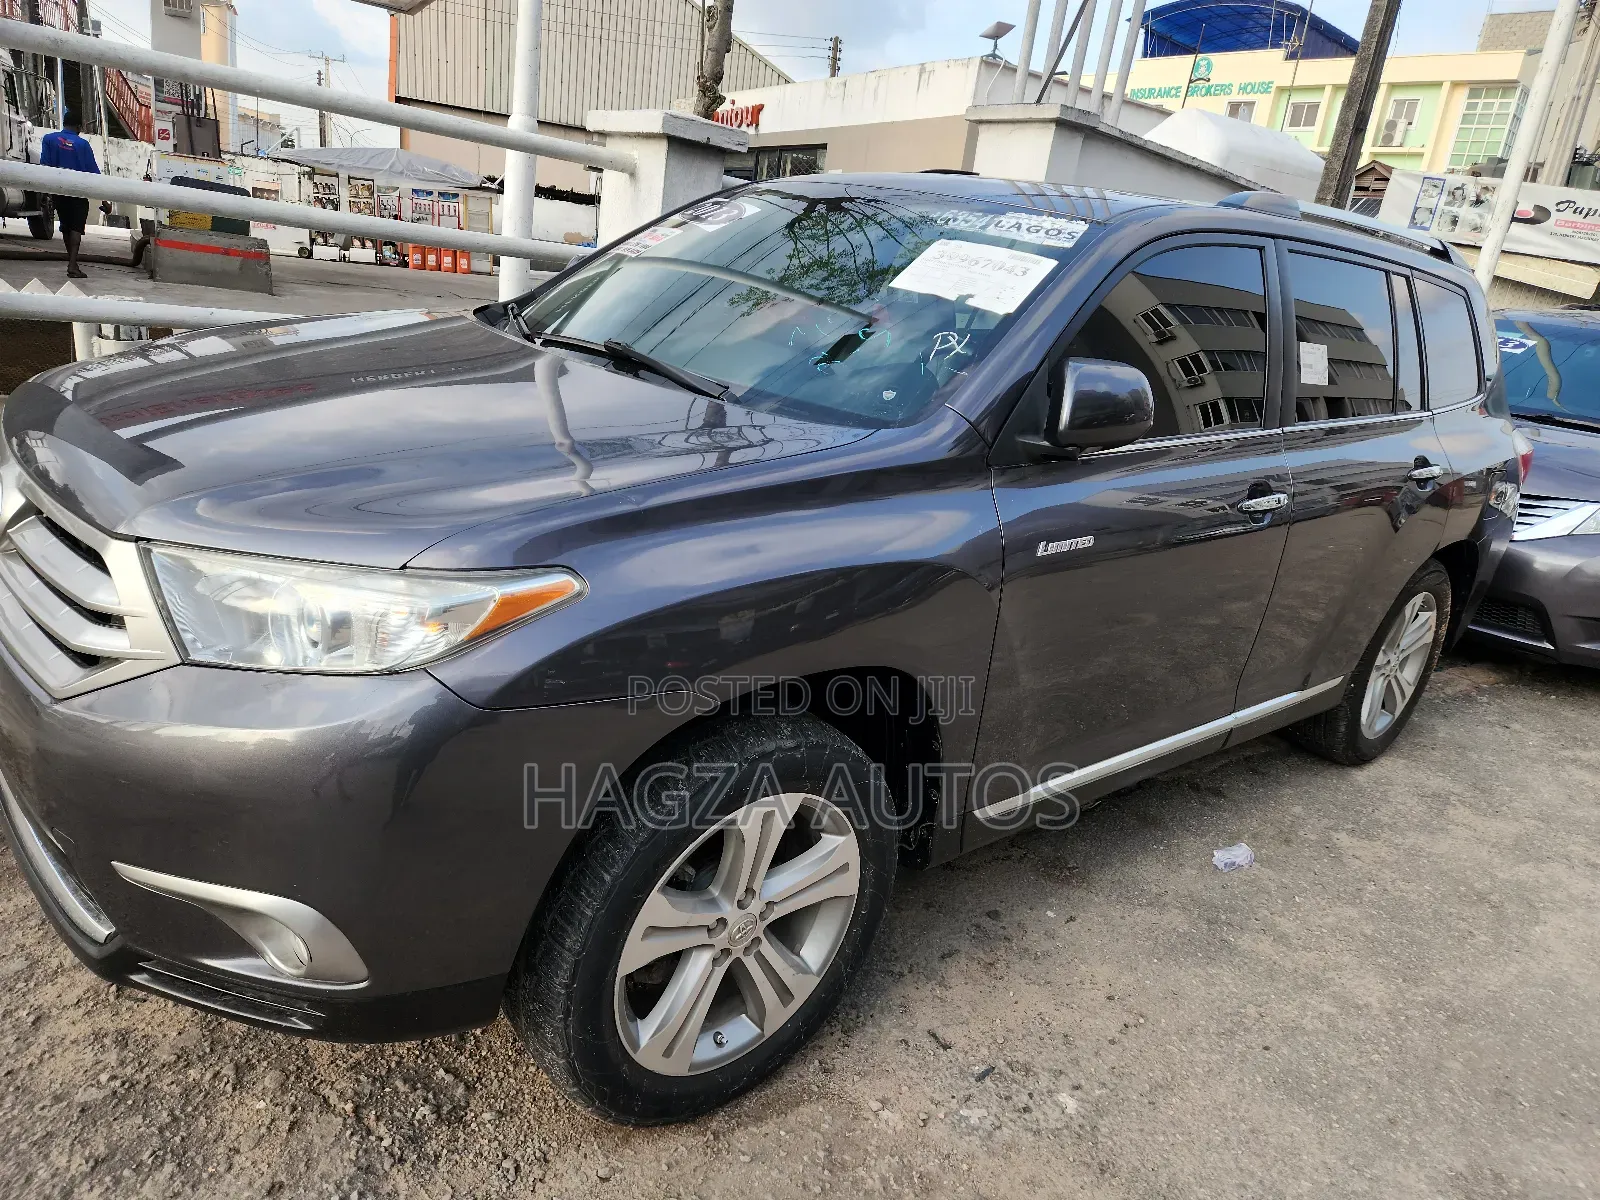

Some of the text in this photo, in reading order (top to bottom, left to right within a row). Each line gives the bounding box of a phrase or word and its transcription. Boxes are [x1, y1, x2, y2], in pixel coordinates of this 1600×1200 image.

[1129, 80, 1275, 100] INSURANCE BROKERS HOUSE
[1555, 199, 1600, 220] Pap
[994, 218, 1081, 240] LAGOS
